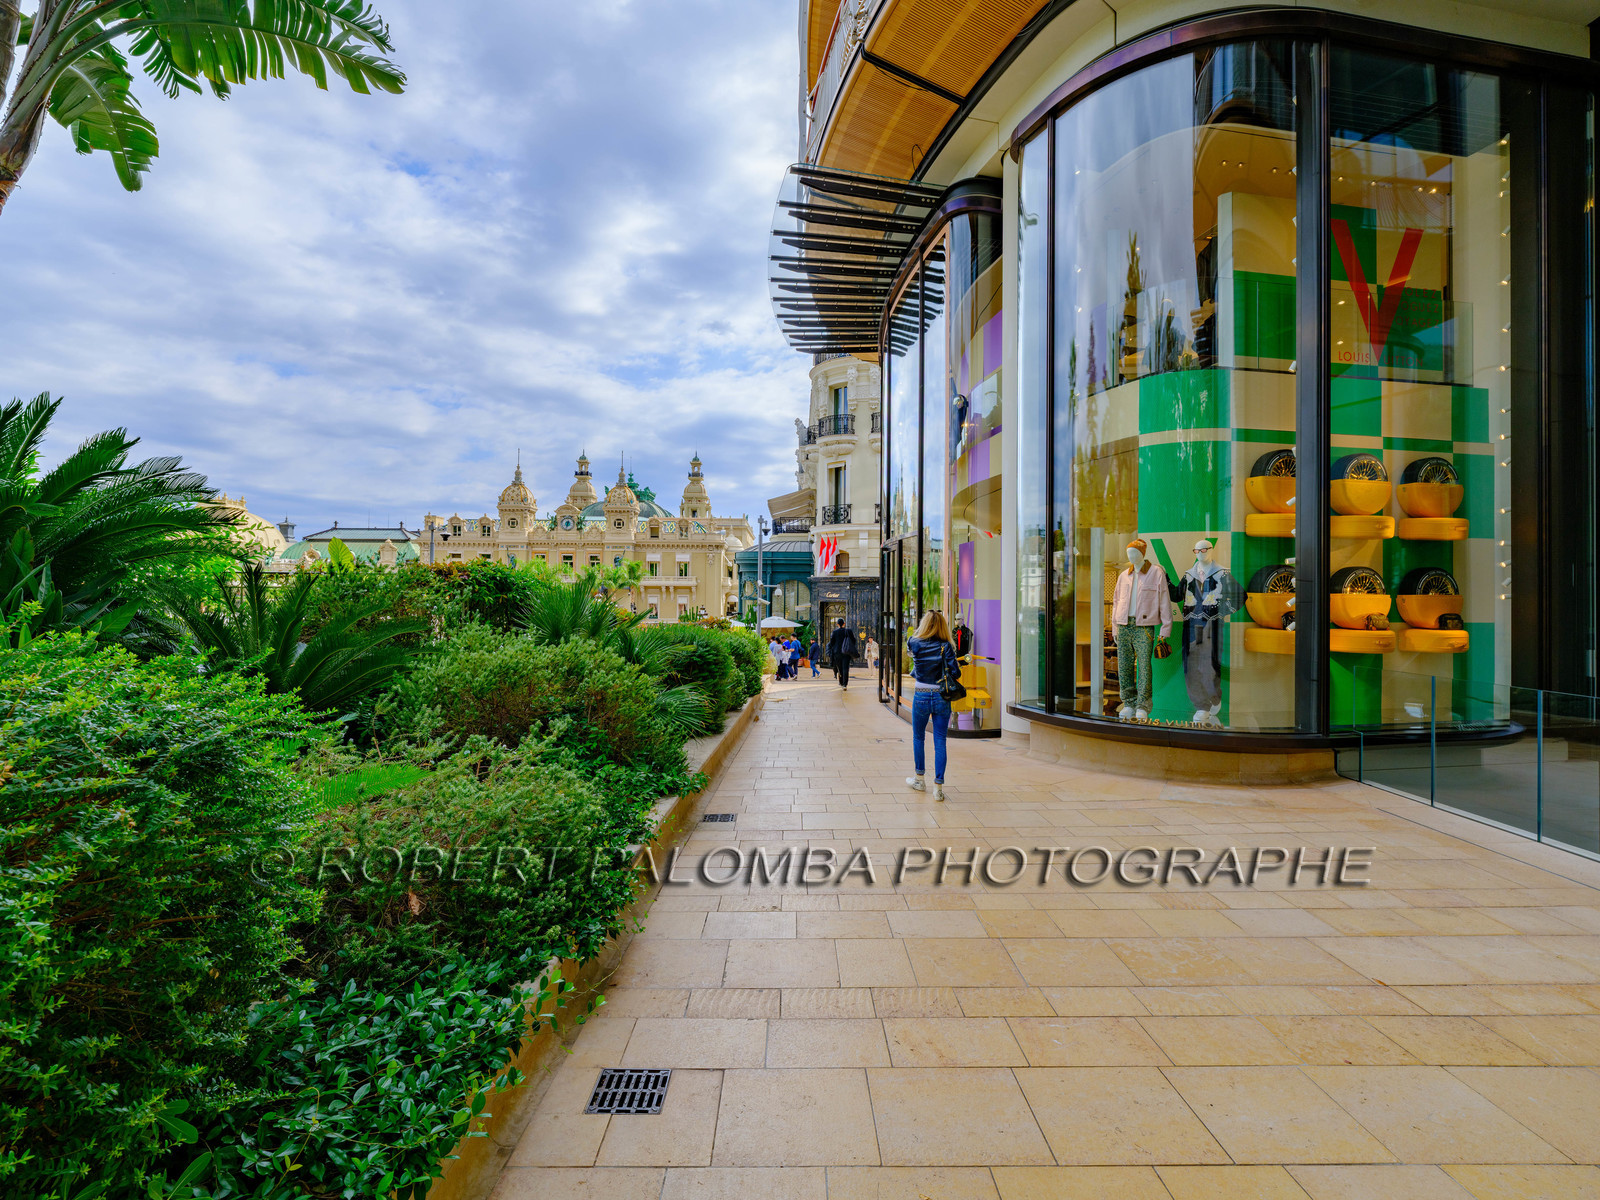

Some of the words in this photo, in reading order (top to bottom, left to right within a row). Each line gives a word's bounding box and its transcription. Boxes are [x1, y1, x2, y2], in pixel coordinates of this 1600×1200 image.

[1338, 351, 1370, 364] LOUIS
[1122, 716, 1160, 726] LOUIS
[1165, 719, 1225, 730] VUITTON
